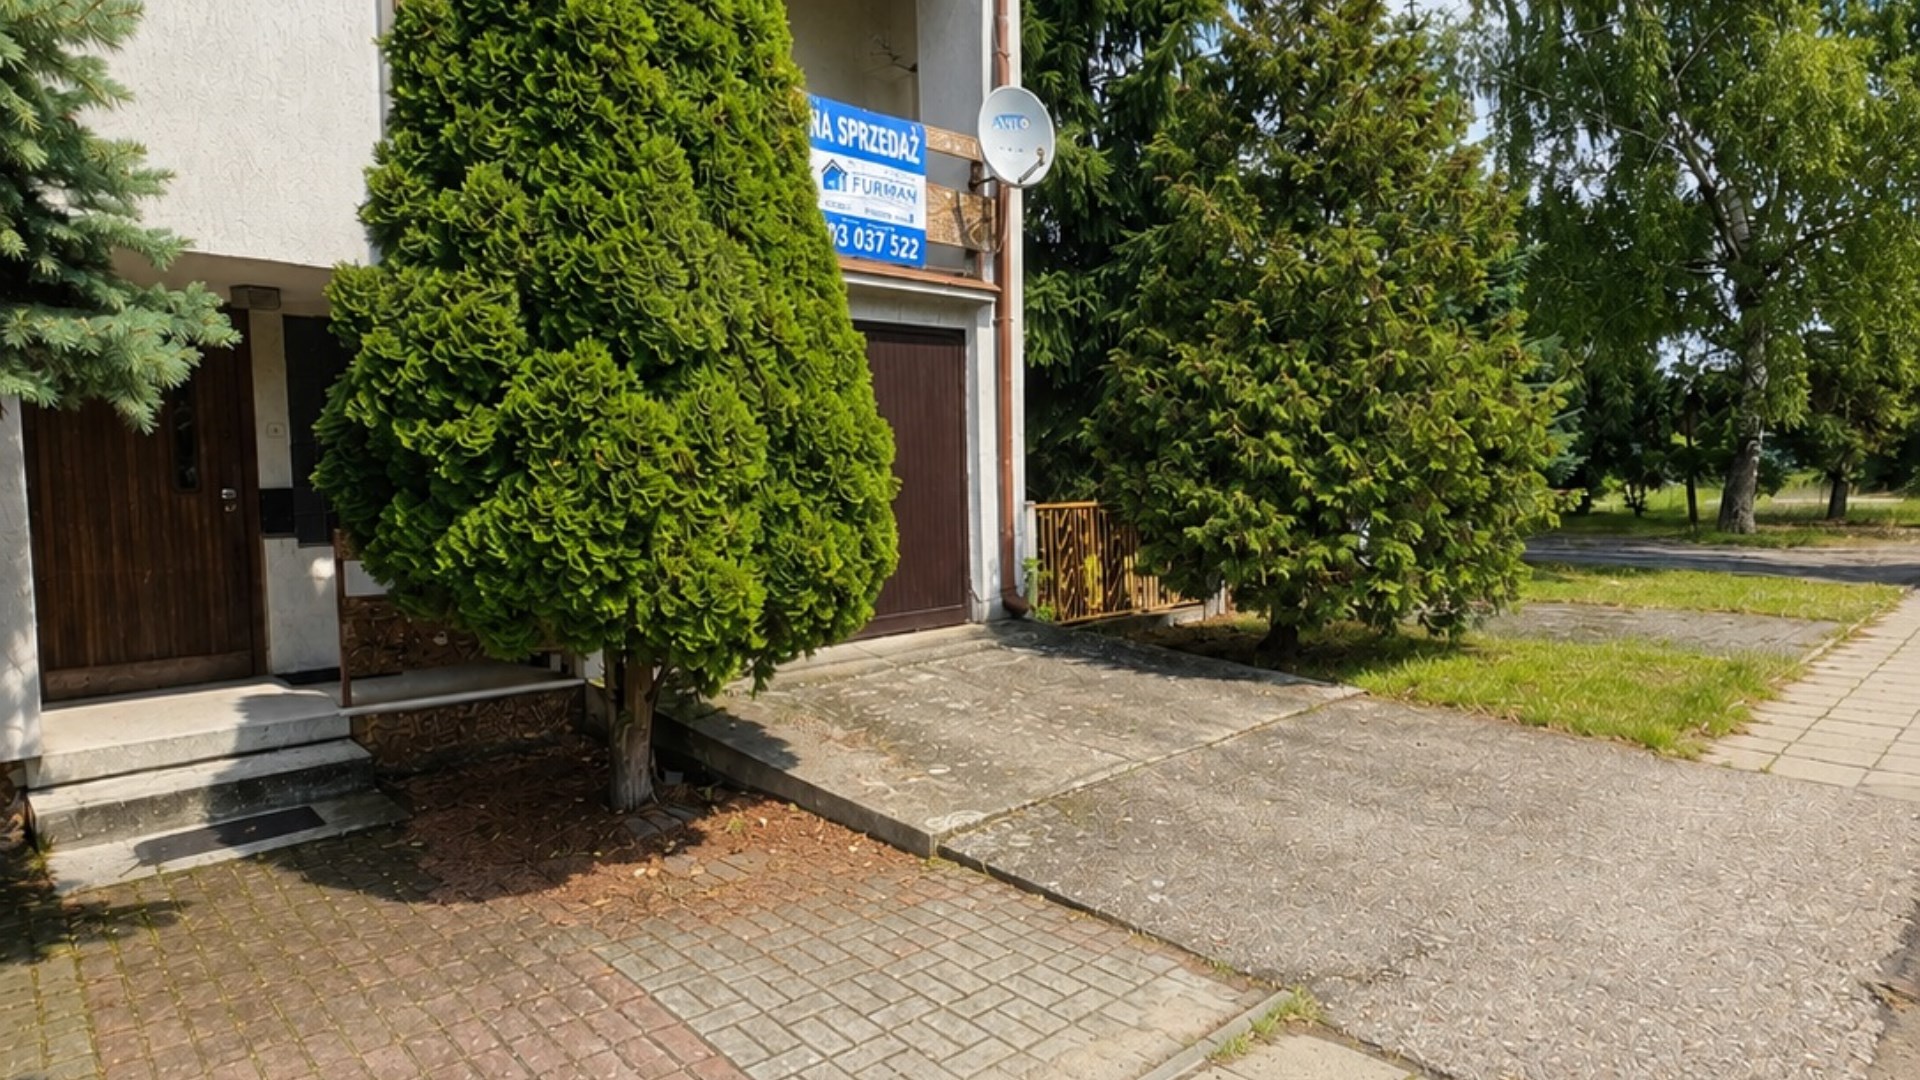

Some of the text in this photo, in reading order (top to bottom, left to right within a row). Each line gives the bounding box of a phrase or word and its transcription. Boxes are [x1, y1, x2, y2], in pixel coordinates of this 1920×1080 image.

[837, 115, 920, 164] SPRZEDAŻ
[853, 226, 885, 253] 037
[890, 234, 919, 259] 522
